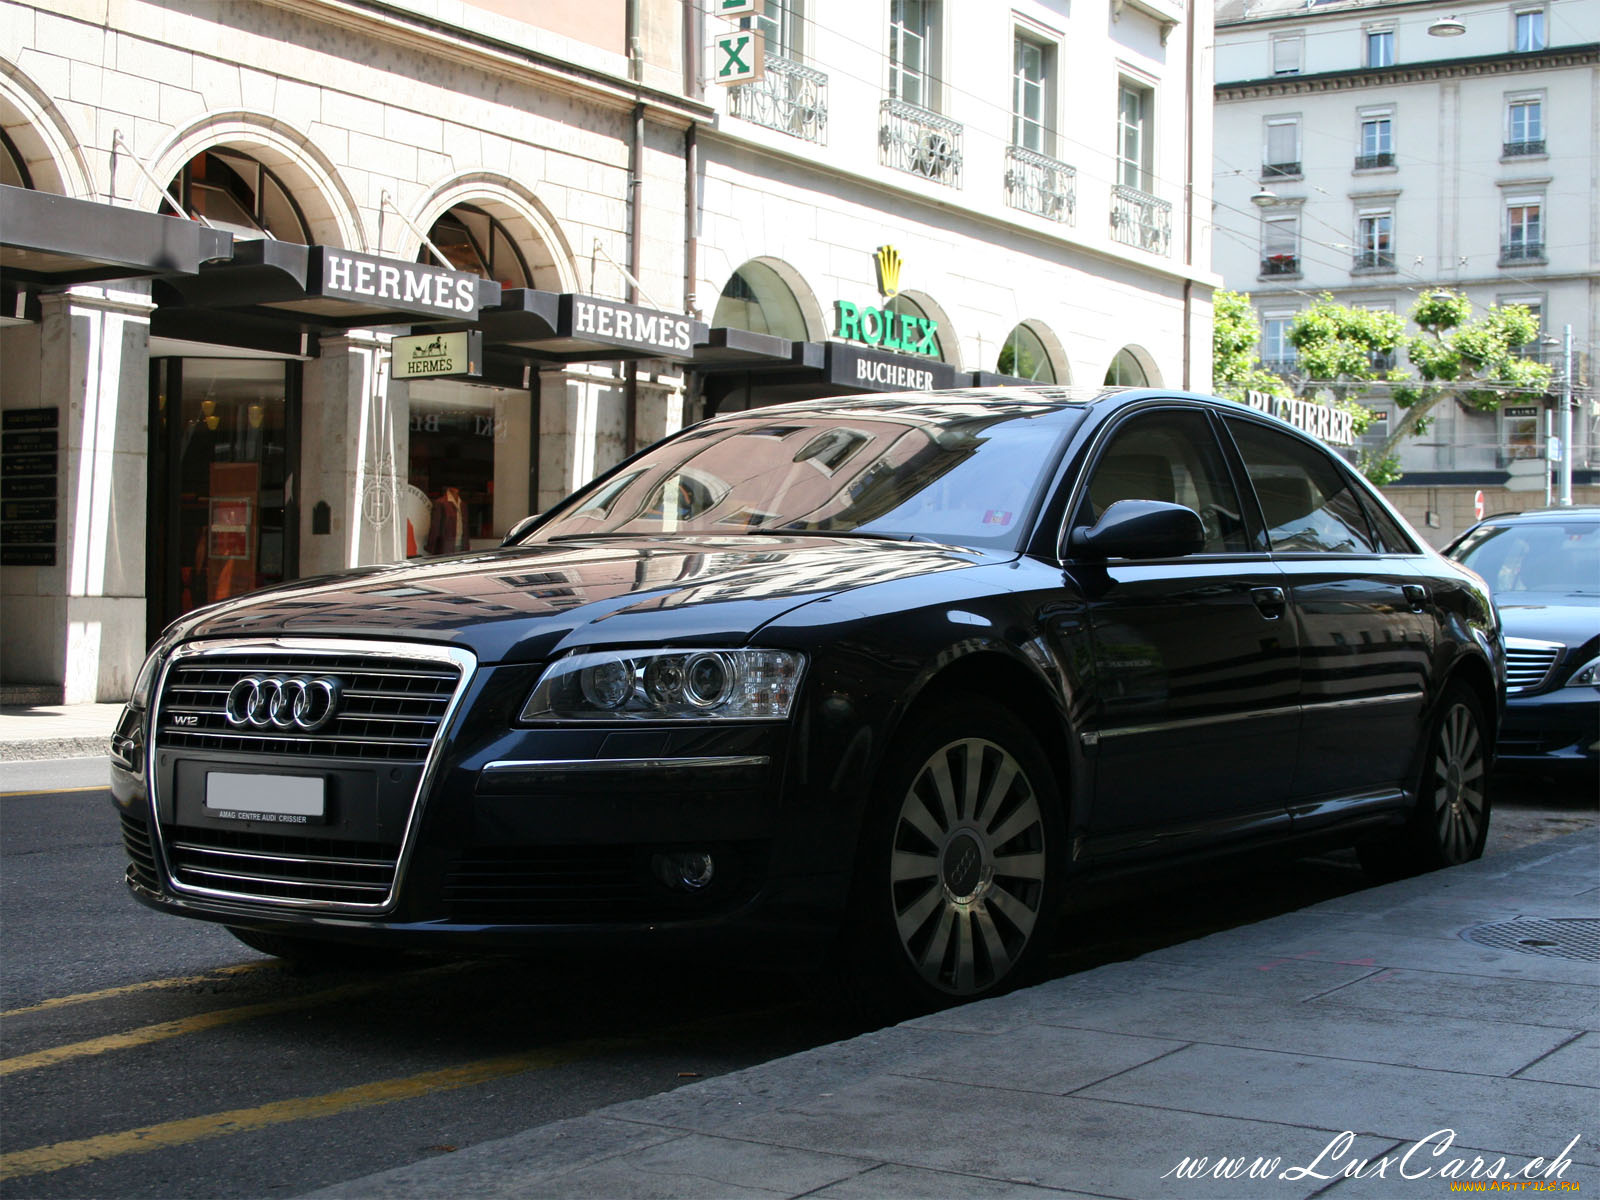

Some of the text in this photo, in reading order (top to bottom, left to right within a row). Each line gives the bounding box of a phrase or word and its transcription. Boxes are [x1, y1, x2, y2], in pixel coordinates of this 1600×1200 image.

[834, 300, 939, 356] ROLEX
[857, 358, 934, 391] BUCHERER
[174, 715, 199, 726] W12
[219, 810, 307, 823] AMAG CENTRE AUDI CRISSIER
